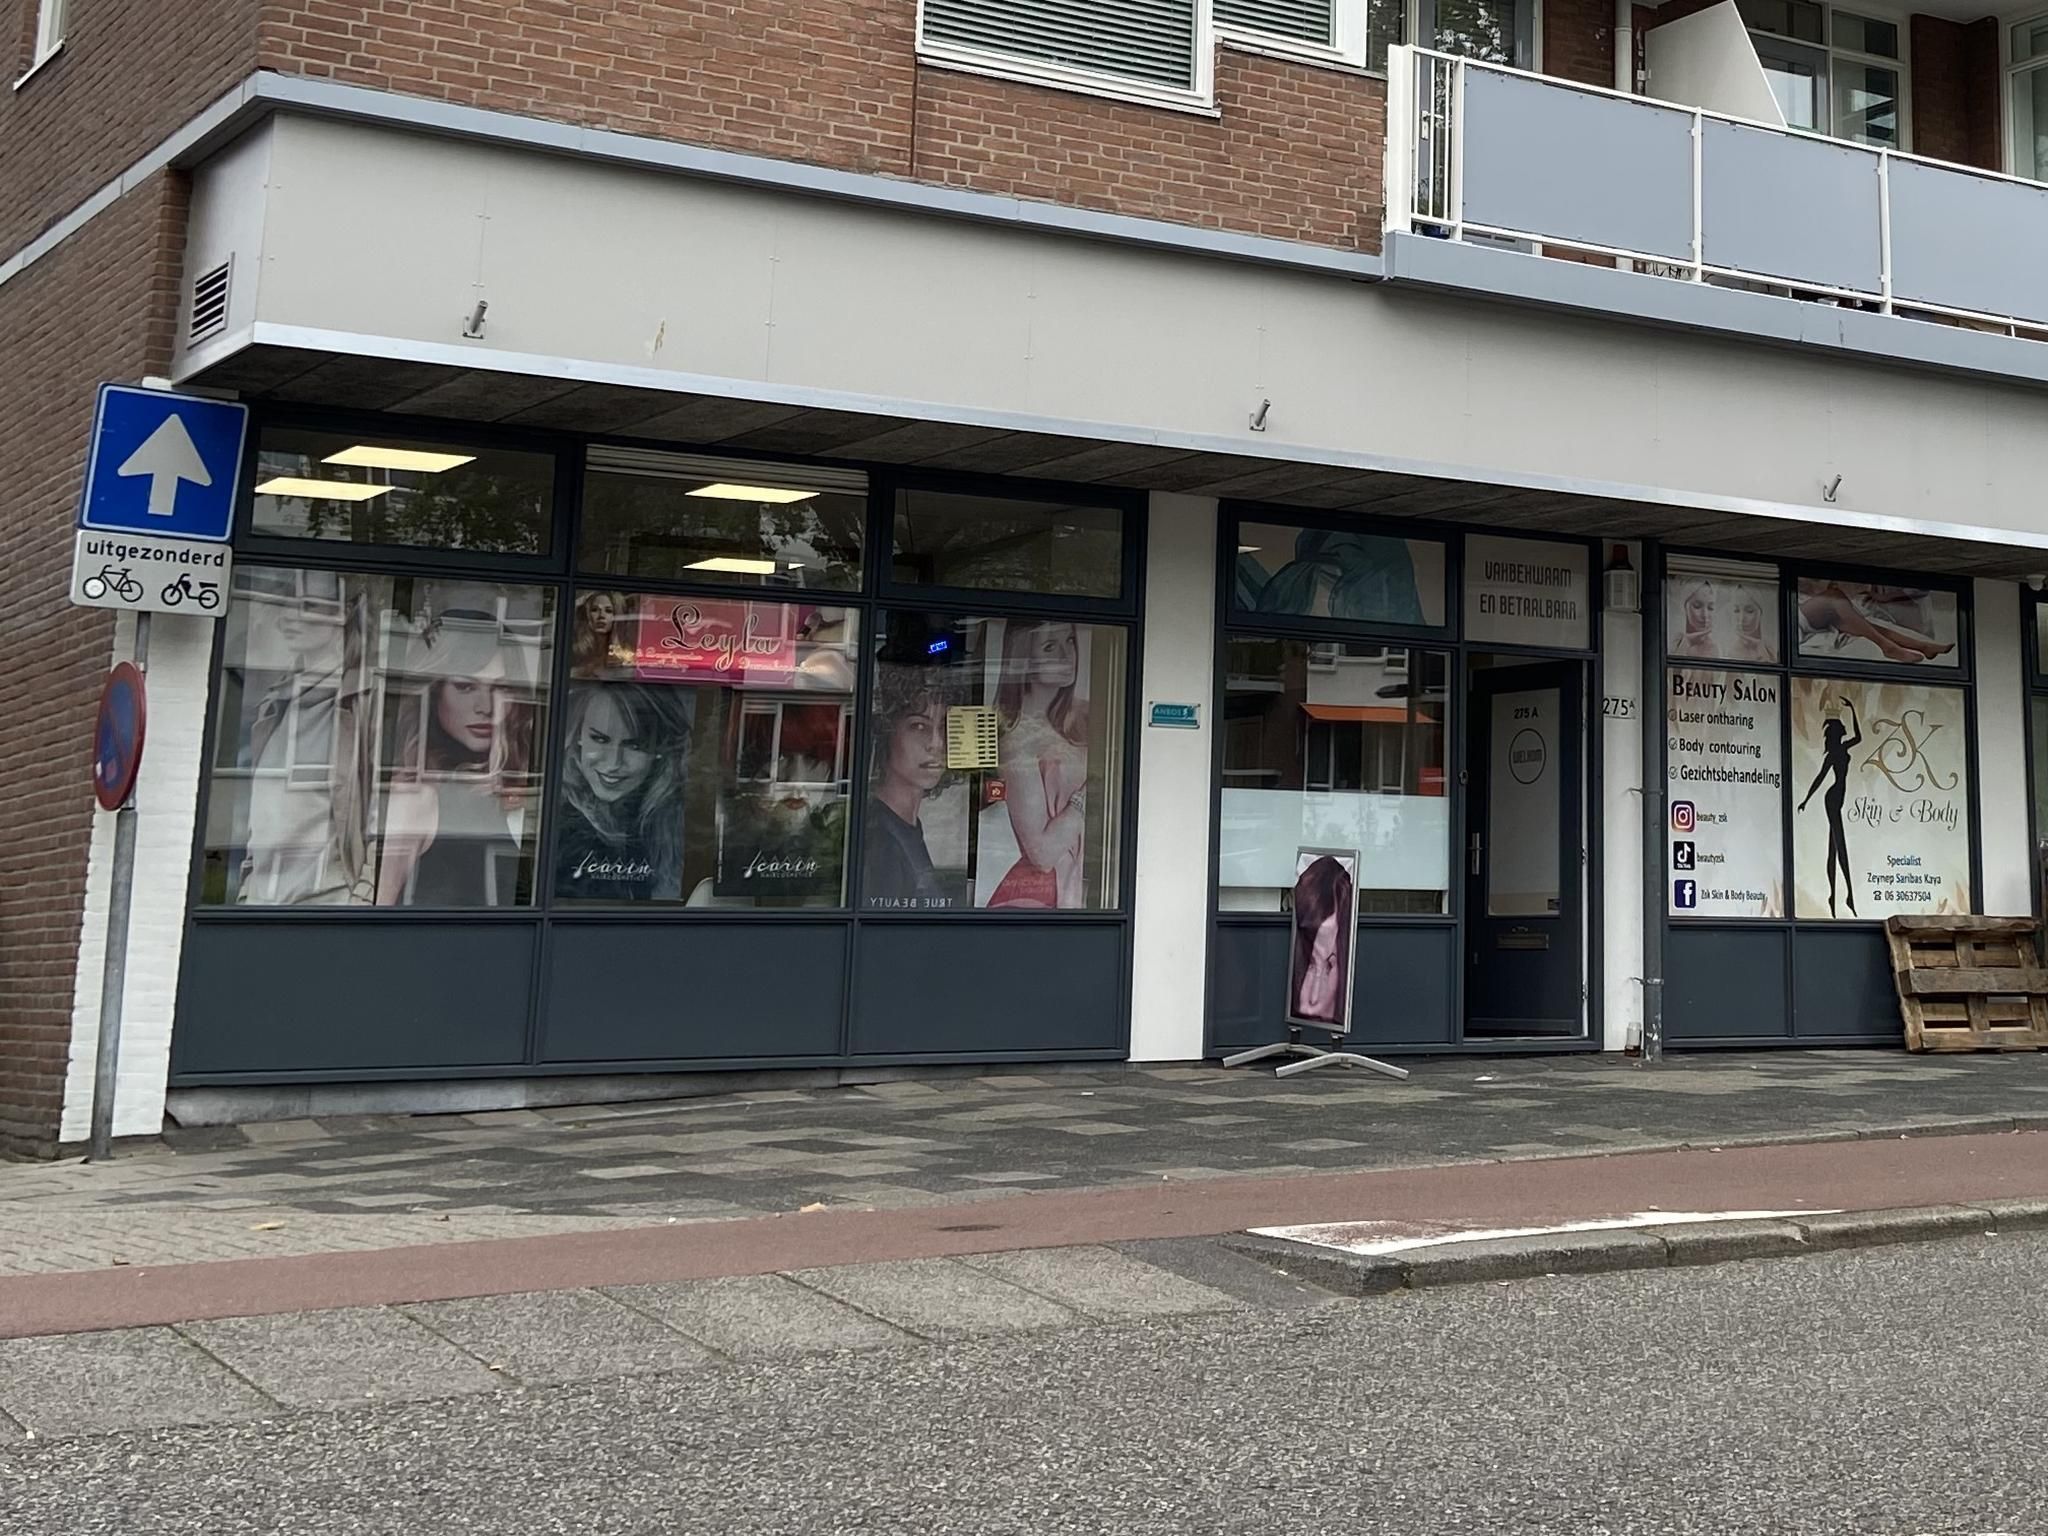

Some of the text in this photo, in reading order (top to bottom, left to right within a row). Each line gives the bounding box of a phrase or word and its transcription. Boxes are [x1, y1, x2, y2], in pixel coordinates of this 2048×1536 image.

[87, 540, 225, 567] uitgezonderd
[1480, 593, 1577, 620] EN BETAALBAAR
[661, 603, 784, 673] Leyla
[1513, 706, 1539, 719] 275 A
[1679, 709, 1754, 730] Laser ontharing
[1679, 738, 1761, 758] Body contouring
[1680, 764, 1781, 788] Gezichtsbehandeling
[1847, 796, 1883, 828] Skin
[1910, 799, 1959, 831] Body
[1886, 855, 1921, 868] Specialist
[1724, 889, 1730, 900] &
[1730, 889, 1745, 903] Body
[1884, 890, 1894, 901] 06
